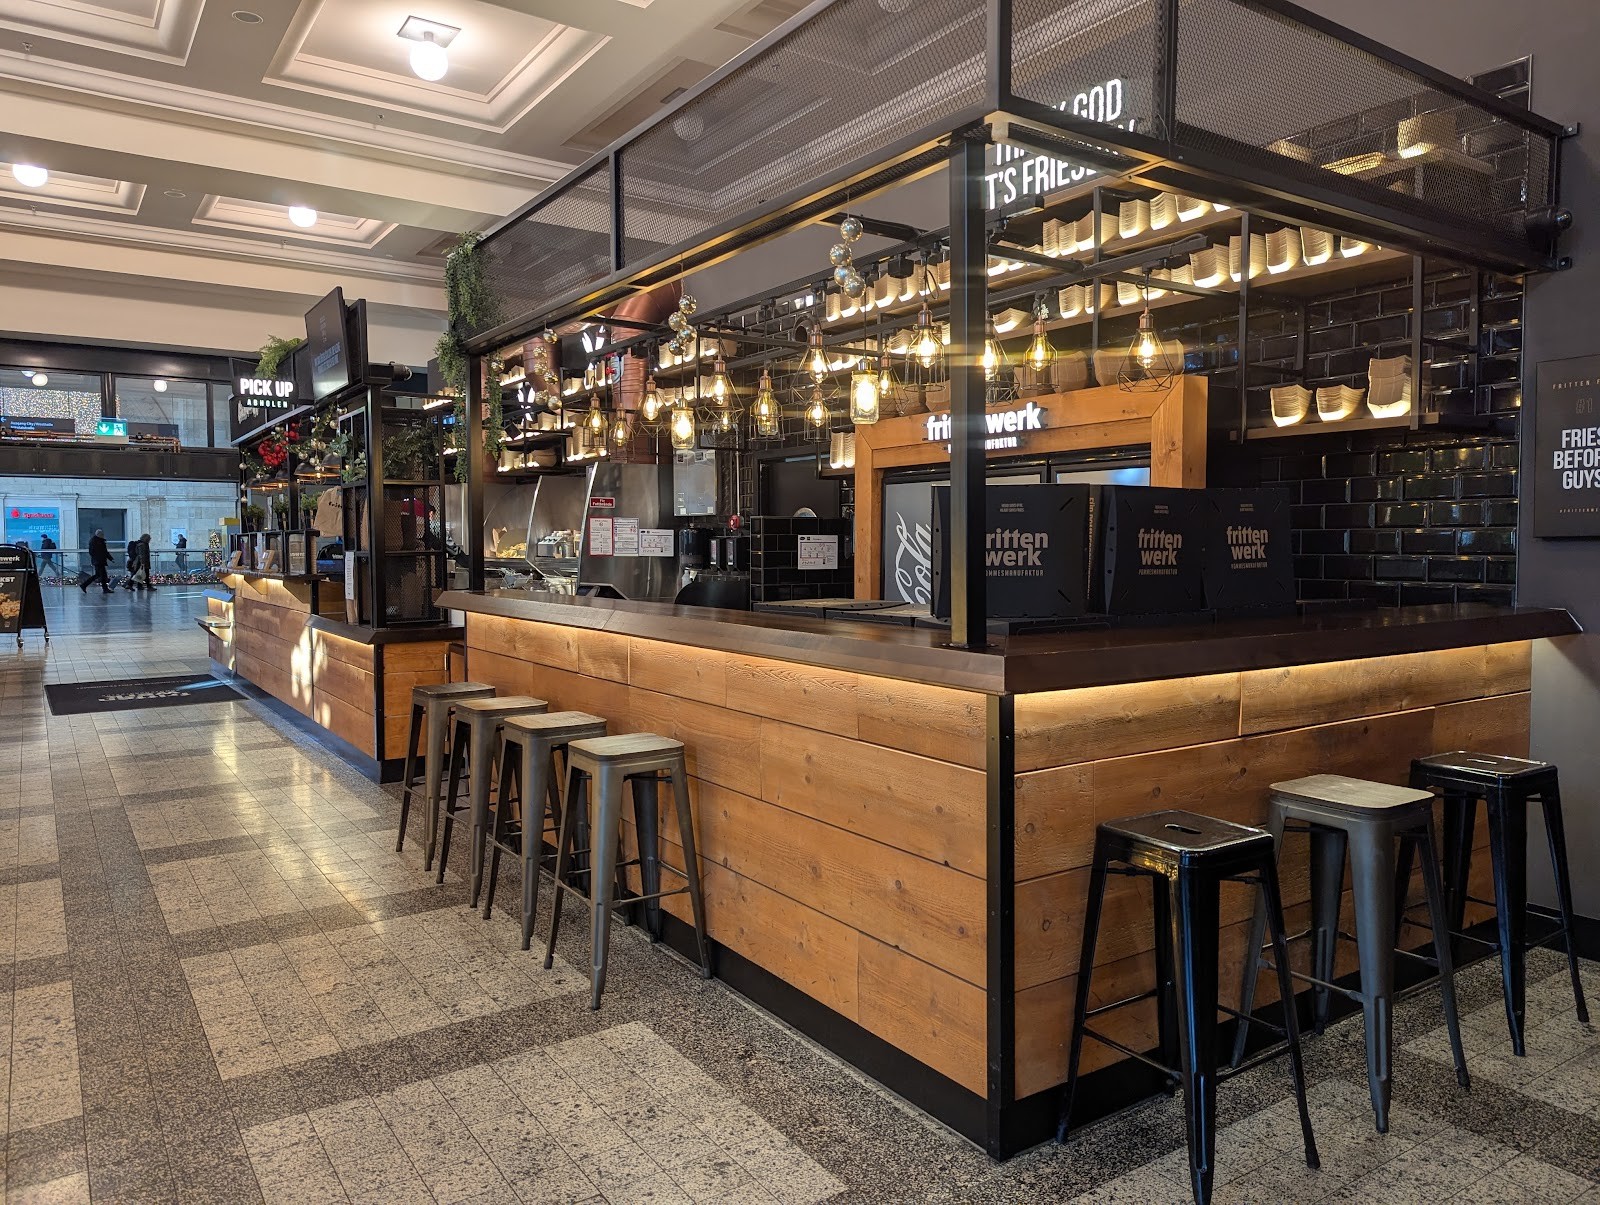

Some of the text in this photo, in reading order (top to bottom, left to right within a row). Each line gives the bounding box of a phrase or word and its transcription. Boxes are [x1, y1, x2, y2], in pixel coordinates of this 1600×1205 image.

[985, 167, 1017, 210] T'S
[240, 378, 294, 398] PICK UP
[246, 398, 288, 408] ABHOLEN
[926, 401, 1042, 441] friwerk
[1553, 448, 1600, 470] BEFOR
[985, 527, 1049, 549] ritten
[1138, 528, 1182, 549] fritten
[1226, 525, 1269, 545] fritten
[985, 544, 1042, 567] werk
[1140, 546, 1177, 566] werk
[1230, 539, 1267, 560] werk
